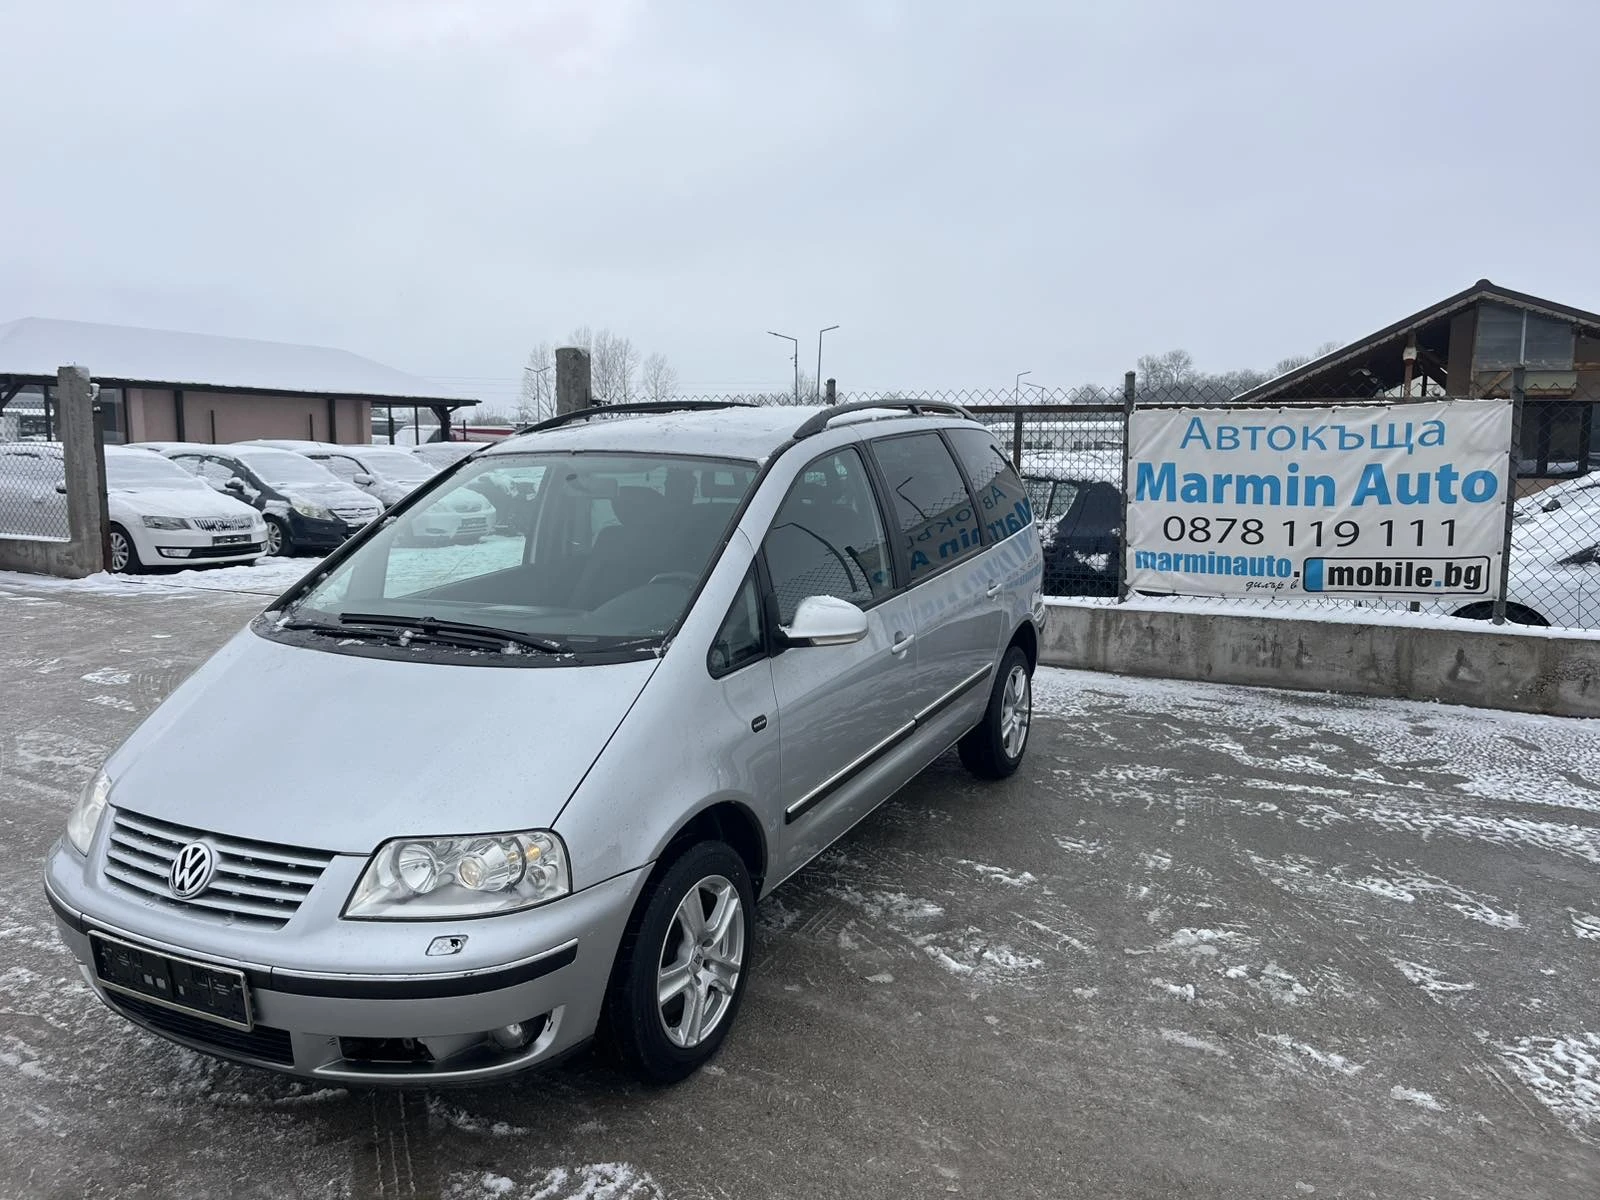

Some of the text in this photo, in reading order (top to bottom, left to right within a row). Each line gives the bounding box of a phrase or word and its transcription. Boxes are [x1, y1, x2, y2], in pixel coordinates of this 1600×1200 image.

[1180, 416, 1446, 454] Автокъща
[1135, 462, 1498, 507] Marmin Auto
[1163, 515, 1456, 547] 0878 119 111
[1327, 561, 1483, 590] mobile.bg
[172, 844, 209, 895] VW
